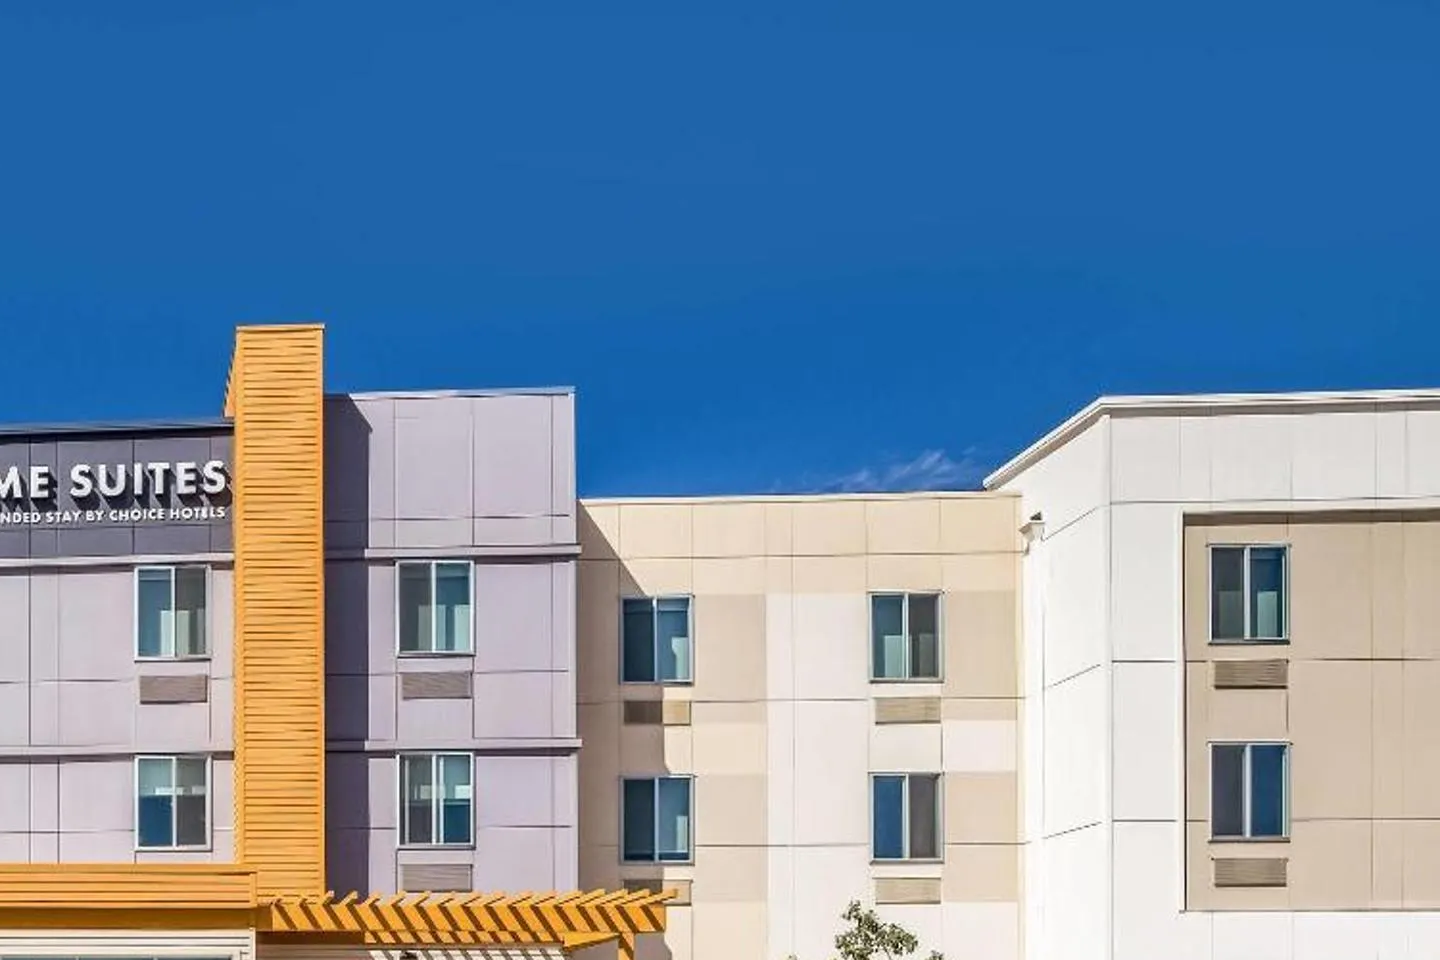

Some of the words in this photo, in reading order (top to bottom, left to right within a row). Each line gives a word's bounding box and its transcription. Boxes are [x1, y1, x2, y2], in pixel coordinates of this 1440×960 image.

[70, 460, 226, 498] SUITES
[45, 511, 82, 524] STAY
[85, 509, 105, 523] BY
[109, 507, 165, 522] CHOICE
[169, 506, 226, 521] HOTELS
